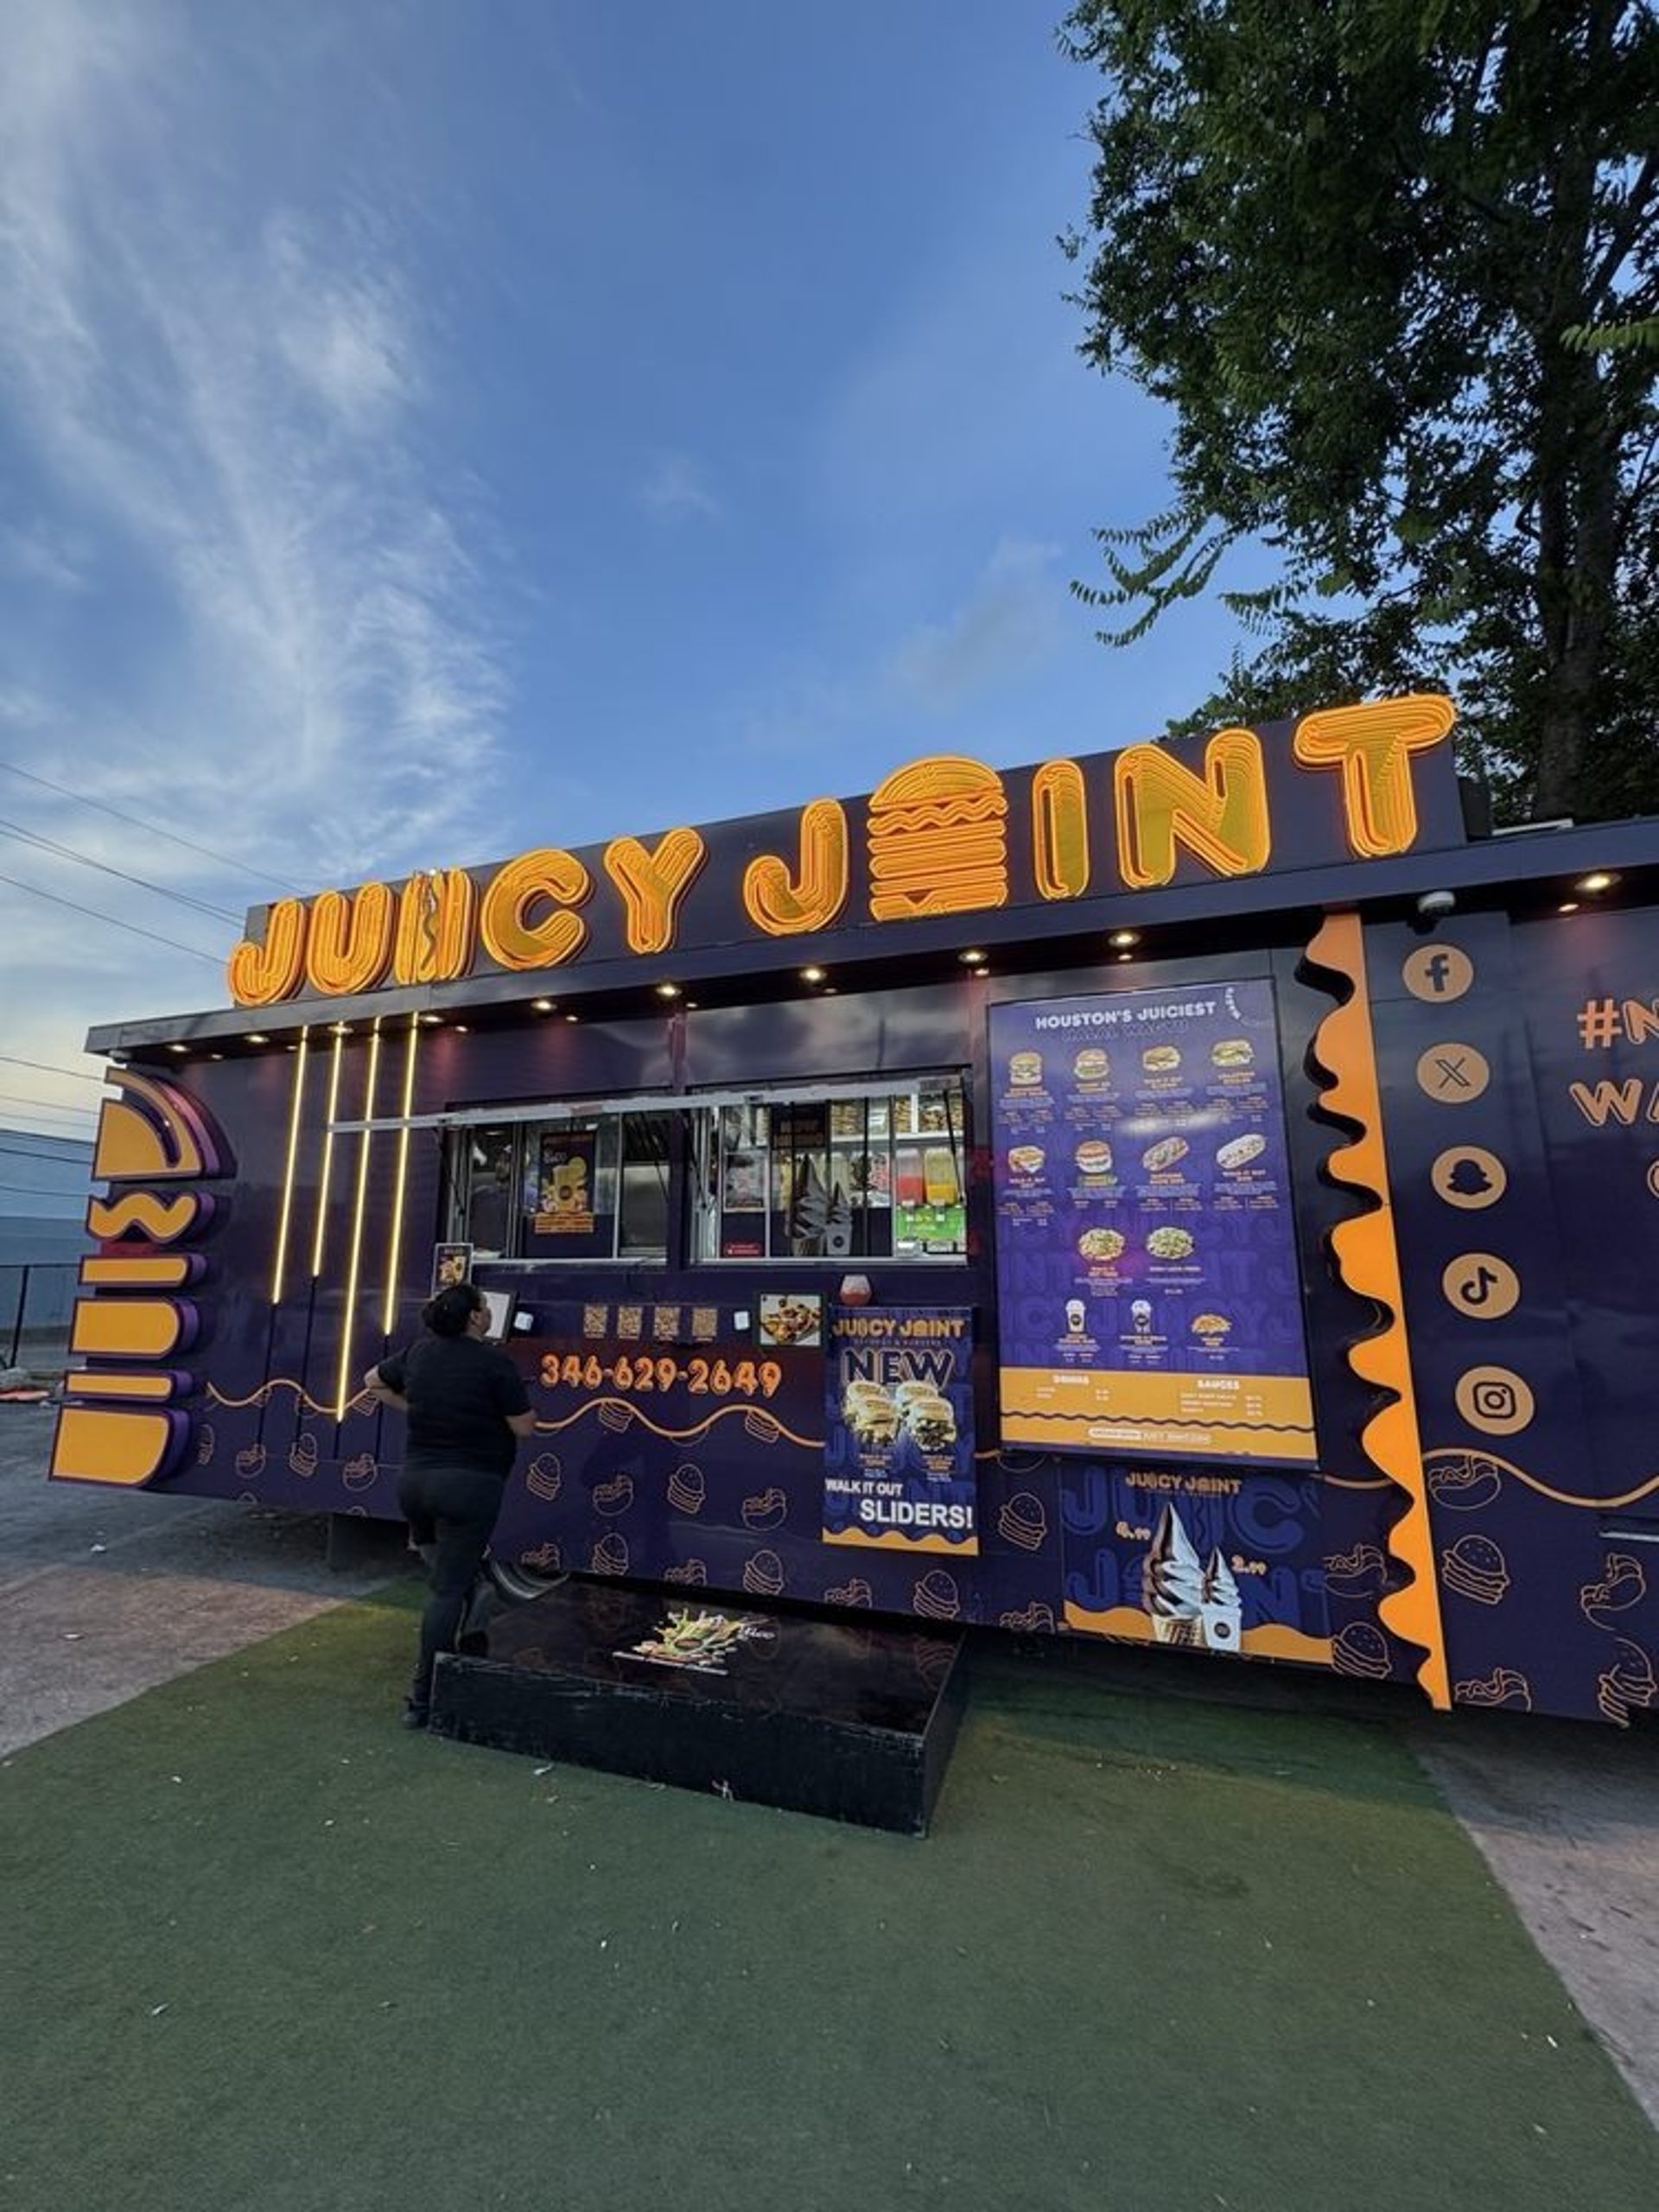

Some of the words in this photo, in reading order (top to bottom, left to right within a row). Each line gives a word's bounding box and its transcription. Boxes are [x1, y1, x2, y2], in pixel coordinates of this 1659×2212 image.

[228, 827, 708, 1008] JUICY
[743, 693, 1457, 938] JOINT
[1035, 1009, 1132, 1030] HOUSTON'S
[1138, 1001, 1216, 1020] JUICIEST
[832, 1317, 896, 1337] JUICY
[899, 1319, 965, 1337] JOINT
[541, 1353, 782, 1398] 346-629-2649
[841, 1347, 955, 1391] NEW
[824, 1478, 861, 1494] WALK
[863, 1480, 874, 1495] IT
[876, 1482, 903, 1497] OUT
[1125, 1471, 1182, 1488] JUICY
[860, 1498, 974, 1529] SLIDERS!
